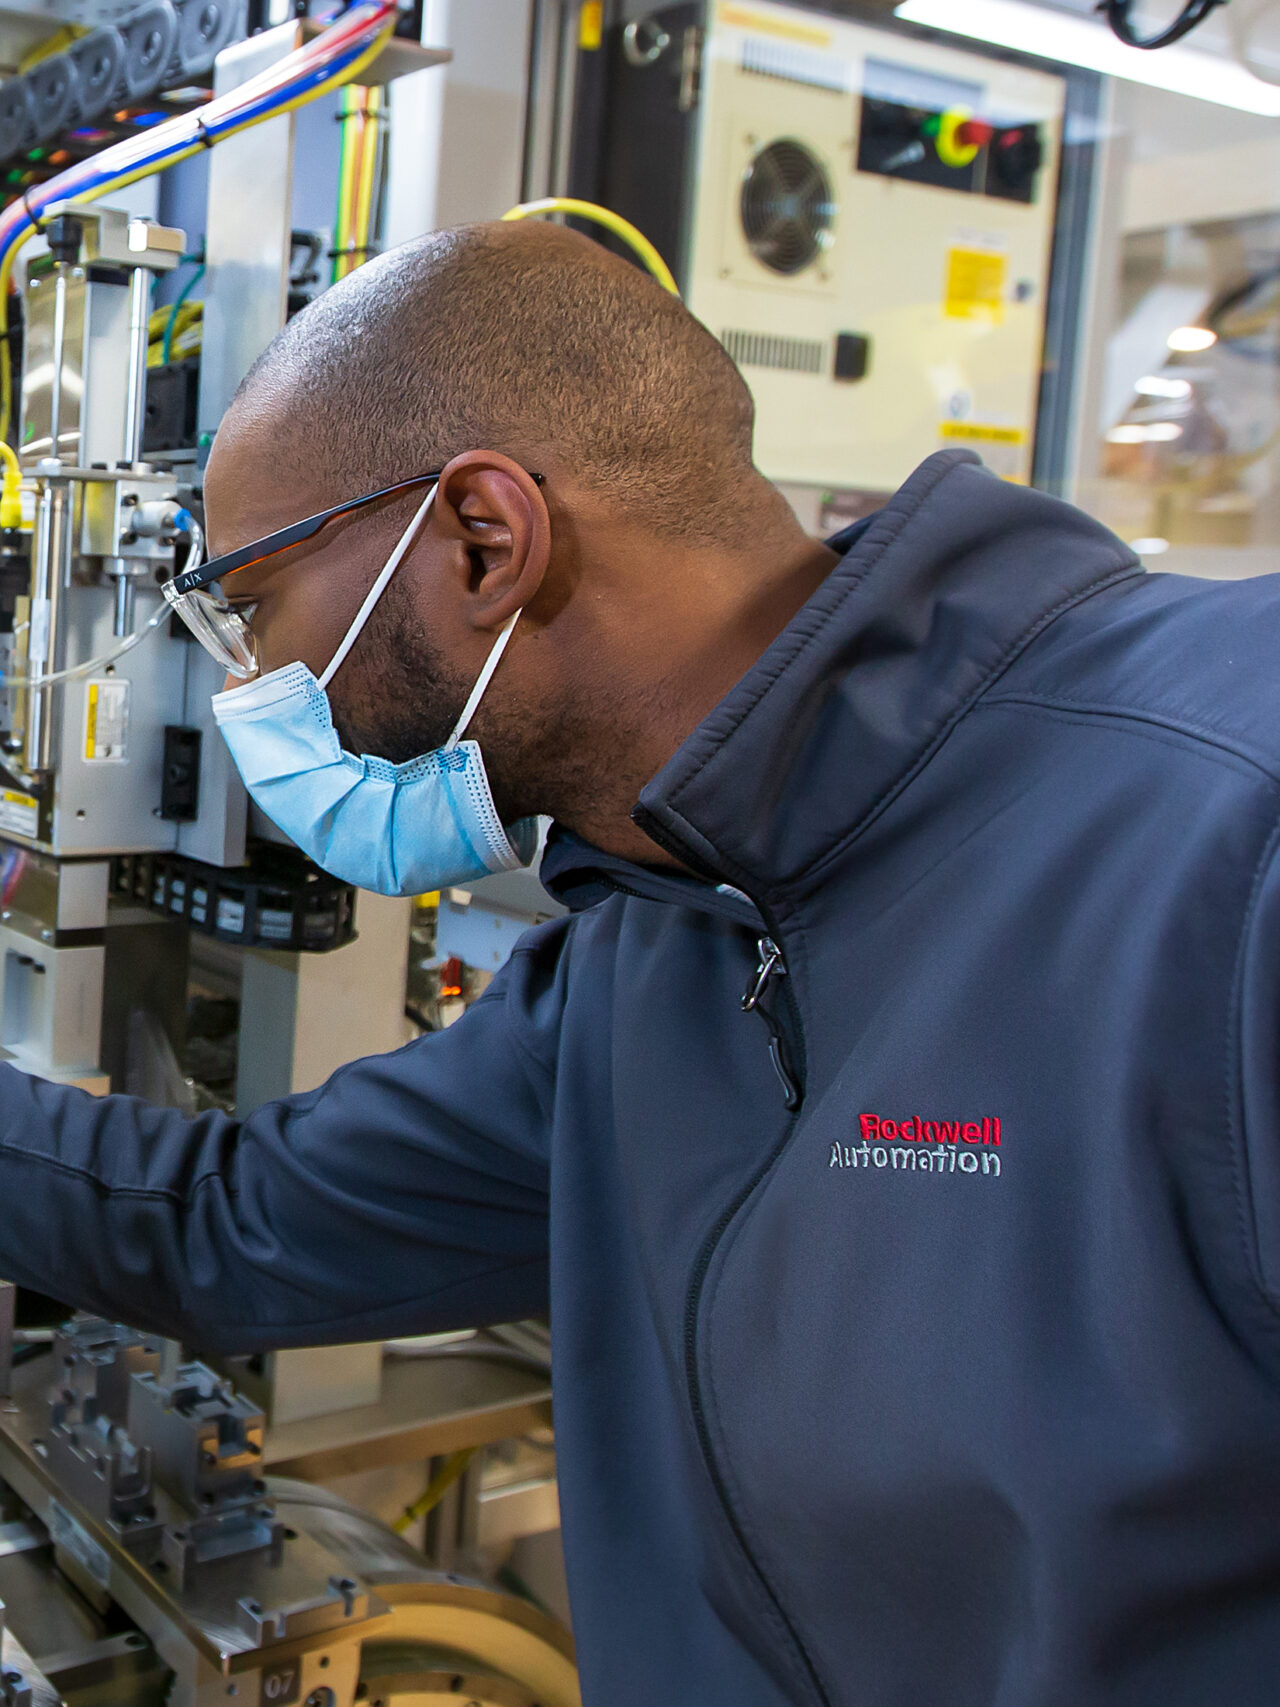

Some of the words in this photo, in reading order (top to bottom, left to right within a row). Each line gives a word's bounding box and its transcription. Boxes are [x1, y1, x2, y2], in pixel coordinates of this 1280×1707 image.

[858, 1113, 1002, 1146] Rockwell
[829, 1140, 1001, 1177] Automation
[264, 1669, 297, 1699] 07
